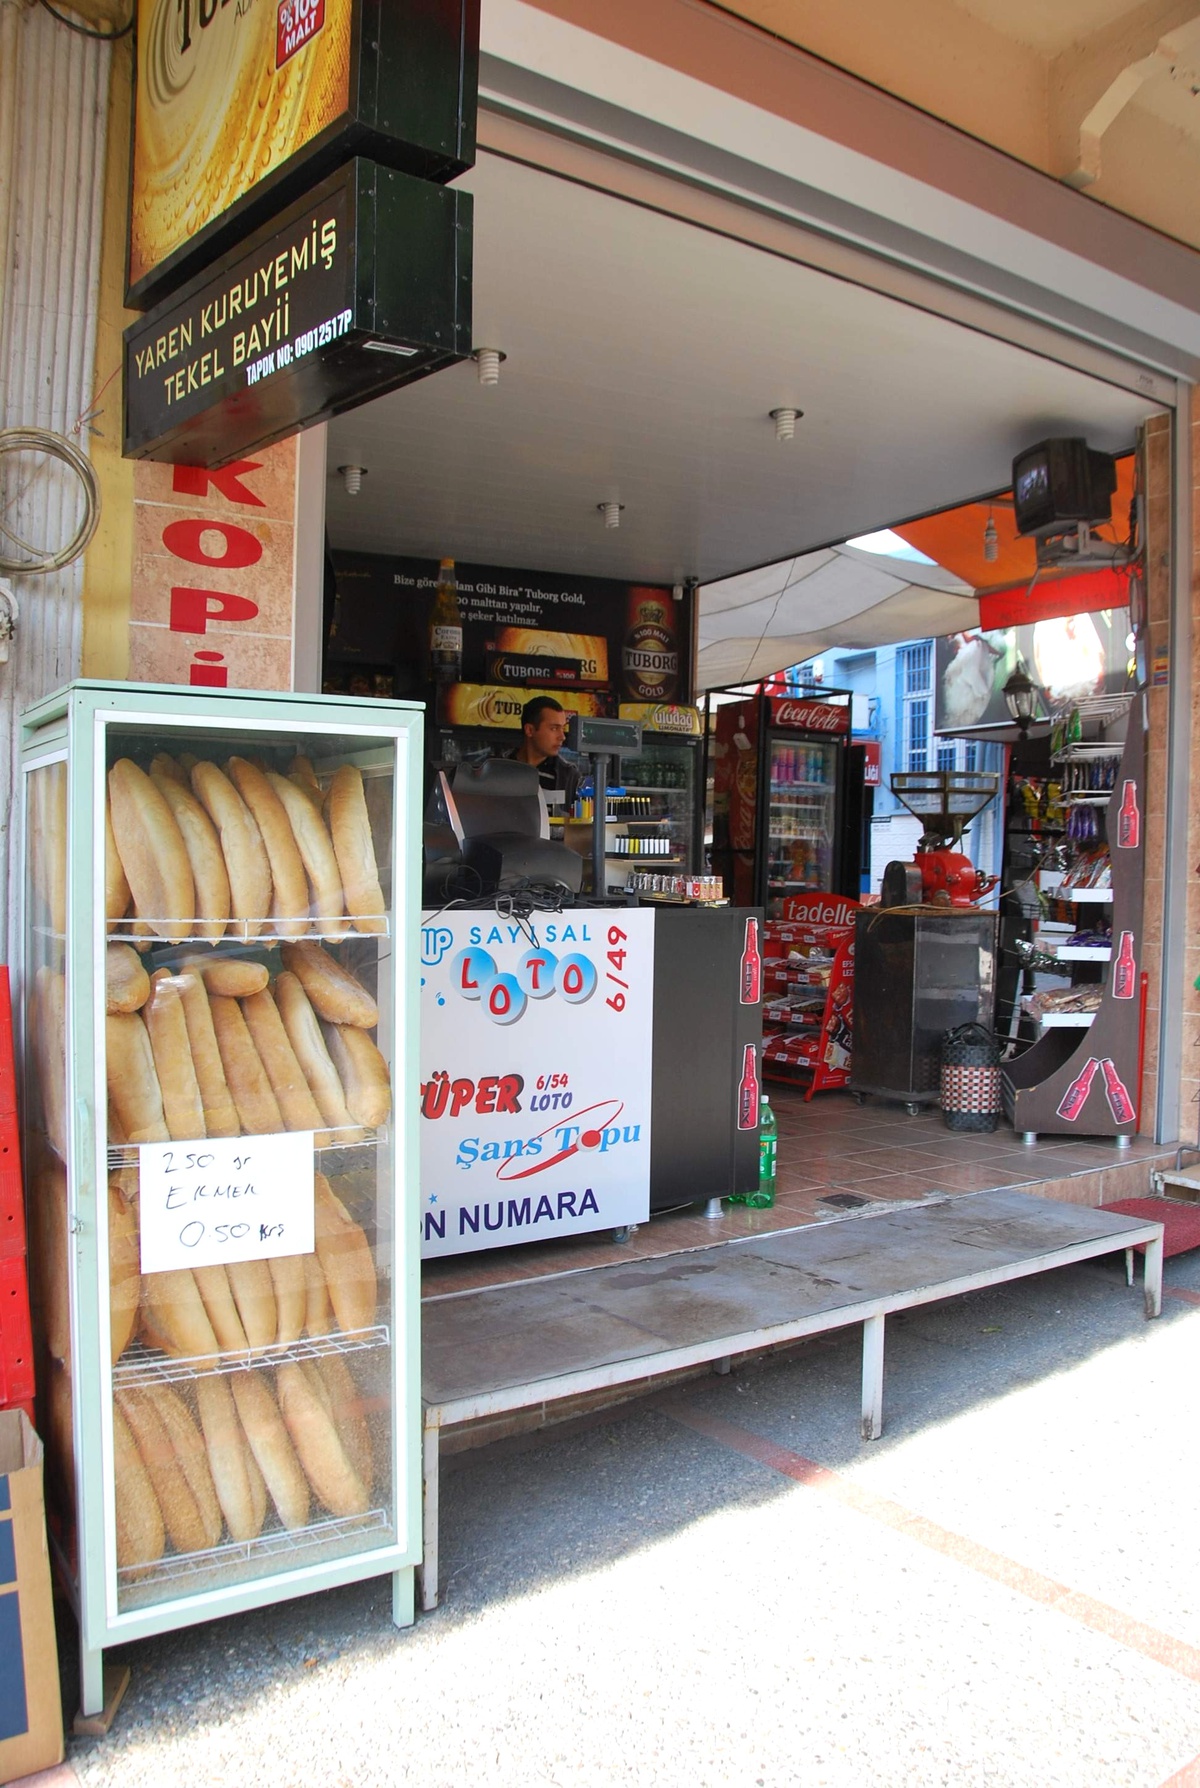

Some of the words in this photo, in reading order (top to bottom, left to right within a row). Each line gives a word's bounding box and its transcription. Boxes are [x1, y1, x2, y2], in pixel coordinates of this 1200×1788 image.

[285, 12, 316, 54] MALT
[135, 318, 193, 379] YAREN
[201, 218, 337, 338] KURUYEMİŞ
[246, 352, 275, 386] TAPDK
[276, 343, 294, 369] NO:
[294, 309, 353, 358] 09012517P
[164, 349, 225, 406] TEKEL
[394, 575, 415, 586] Bize
[417, 579, 438, 590] göre
[476, 583, 497, 595] Gibi
[524, 589, 559, 603] Tuborg
[560, 593, 586, 606] Gold,
[470, 597, 508, 610] malttan
[509, 602, 543, 614] yapılır,
[468, 612, 493, 622] şeker
[496, 614, 538, 626] katılmaz.
[625, 651, 678, 671] TUBORG
[638, 684, 664, 697] GOLD
[775, 700, 841, 731] Coca-Cola
[787, 900, 856, 926] tadelle
[469, 924, 592, 945] SAYISAL
[461, 957, 585, 1016] LOTO
[605, 926, 629, 1013] 6/49
[420, 1070, 524, 1120] ÜPER
[536, 1073, 569, 1091] 6/54
[529, 1091, 574, 1112] LOTO
[163, 1151, 215, 1173] 250
[456, 1136, 543, 1170] Şans
[420, 1209, 446, 1241] N
[459, 1187, 601, 1236] NUMARA
